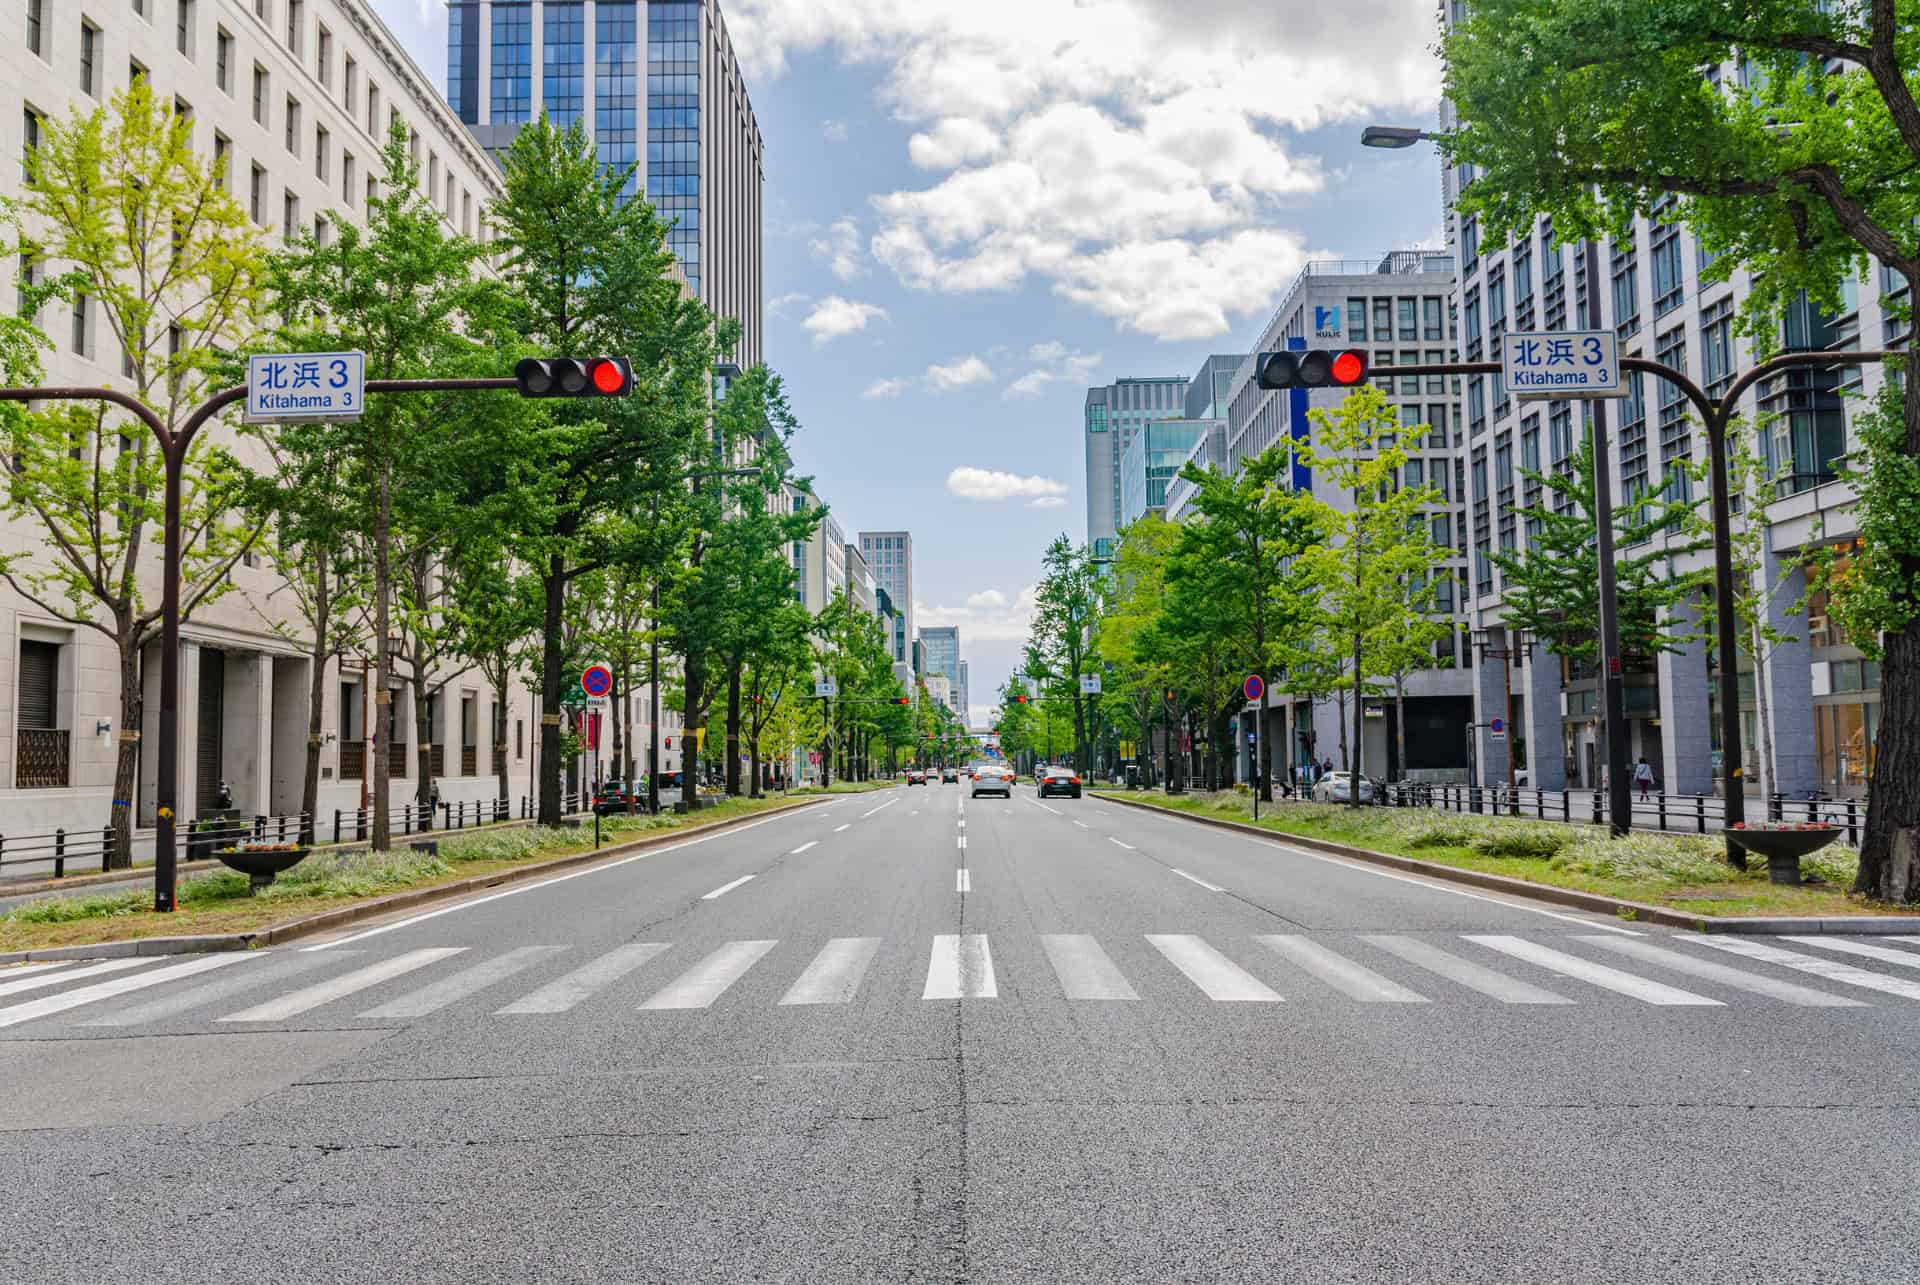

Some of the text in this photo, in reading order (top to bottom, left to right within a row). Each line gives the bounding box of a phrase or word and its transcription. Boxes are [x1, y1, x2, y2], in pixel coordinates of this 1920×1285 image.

[1514, 337, 1603, 366] 北浜3
[260, 360, 349, 389] 北浜3
[1514, 369, 1609, 385] Kitahama 3
[259, 392, 353, 409] Kitahama 3
